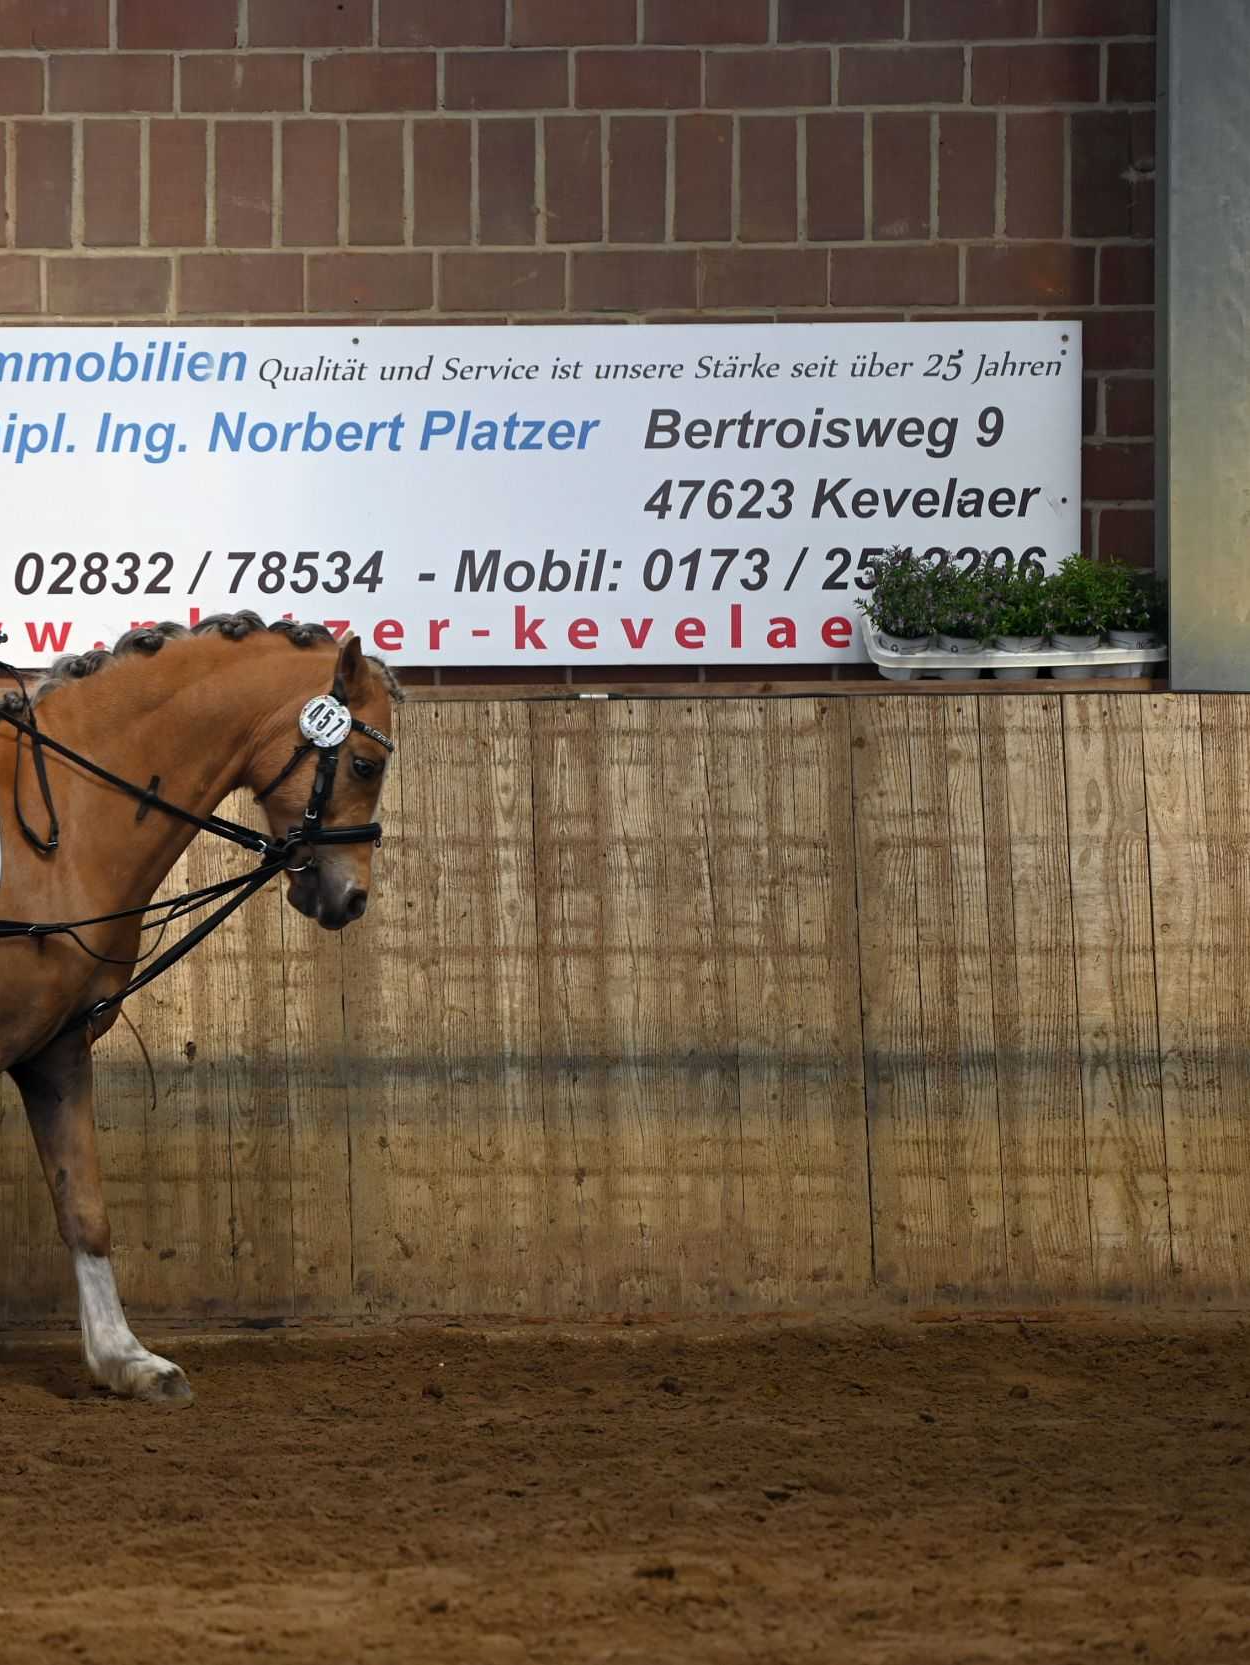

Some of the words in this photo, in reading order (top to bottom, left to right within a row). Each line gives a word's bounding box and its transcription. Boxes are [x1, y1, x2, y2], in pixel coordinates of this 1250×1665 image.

[259, 355, 368, 390] Qualität
[379, 355, 432, 381] und
[442, 357, 540, 382] Service
[551, 356, 583, 381] ist
[595, 363, 685, 381] unsere
[694, 352, 781, 380] Stärke
[790, 358, 839, 380] seit
[850, 352, 914, 380] über
[922, 349, 964, 381] 25
[970, 350, 1062, 385] Jahren
[96, 411, 188, 465] Ing.
[208, 409, 406, 454] Norbert
[418, 408, 601, 453] Platzer
[644, 407, 959, 459] Bertroisweg
[975, 405, 1005, 448] 9
[643, 478, 795, 520] 47623
[810, 477, 1042, 519] Kevelaer
[14, 551, 174, 596] 02832
[227, 550, 384, 594] 78534
[418, 572, 436, 583] -
[453, 548, 623, 593] Mobil:
[642, 547, 770, 592] 0173
[822, 546, 1047, 590] 25226
